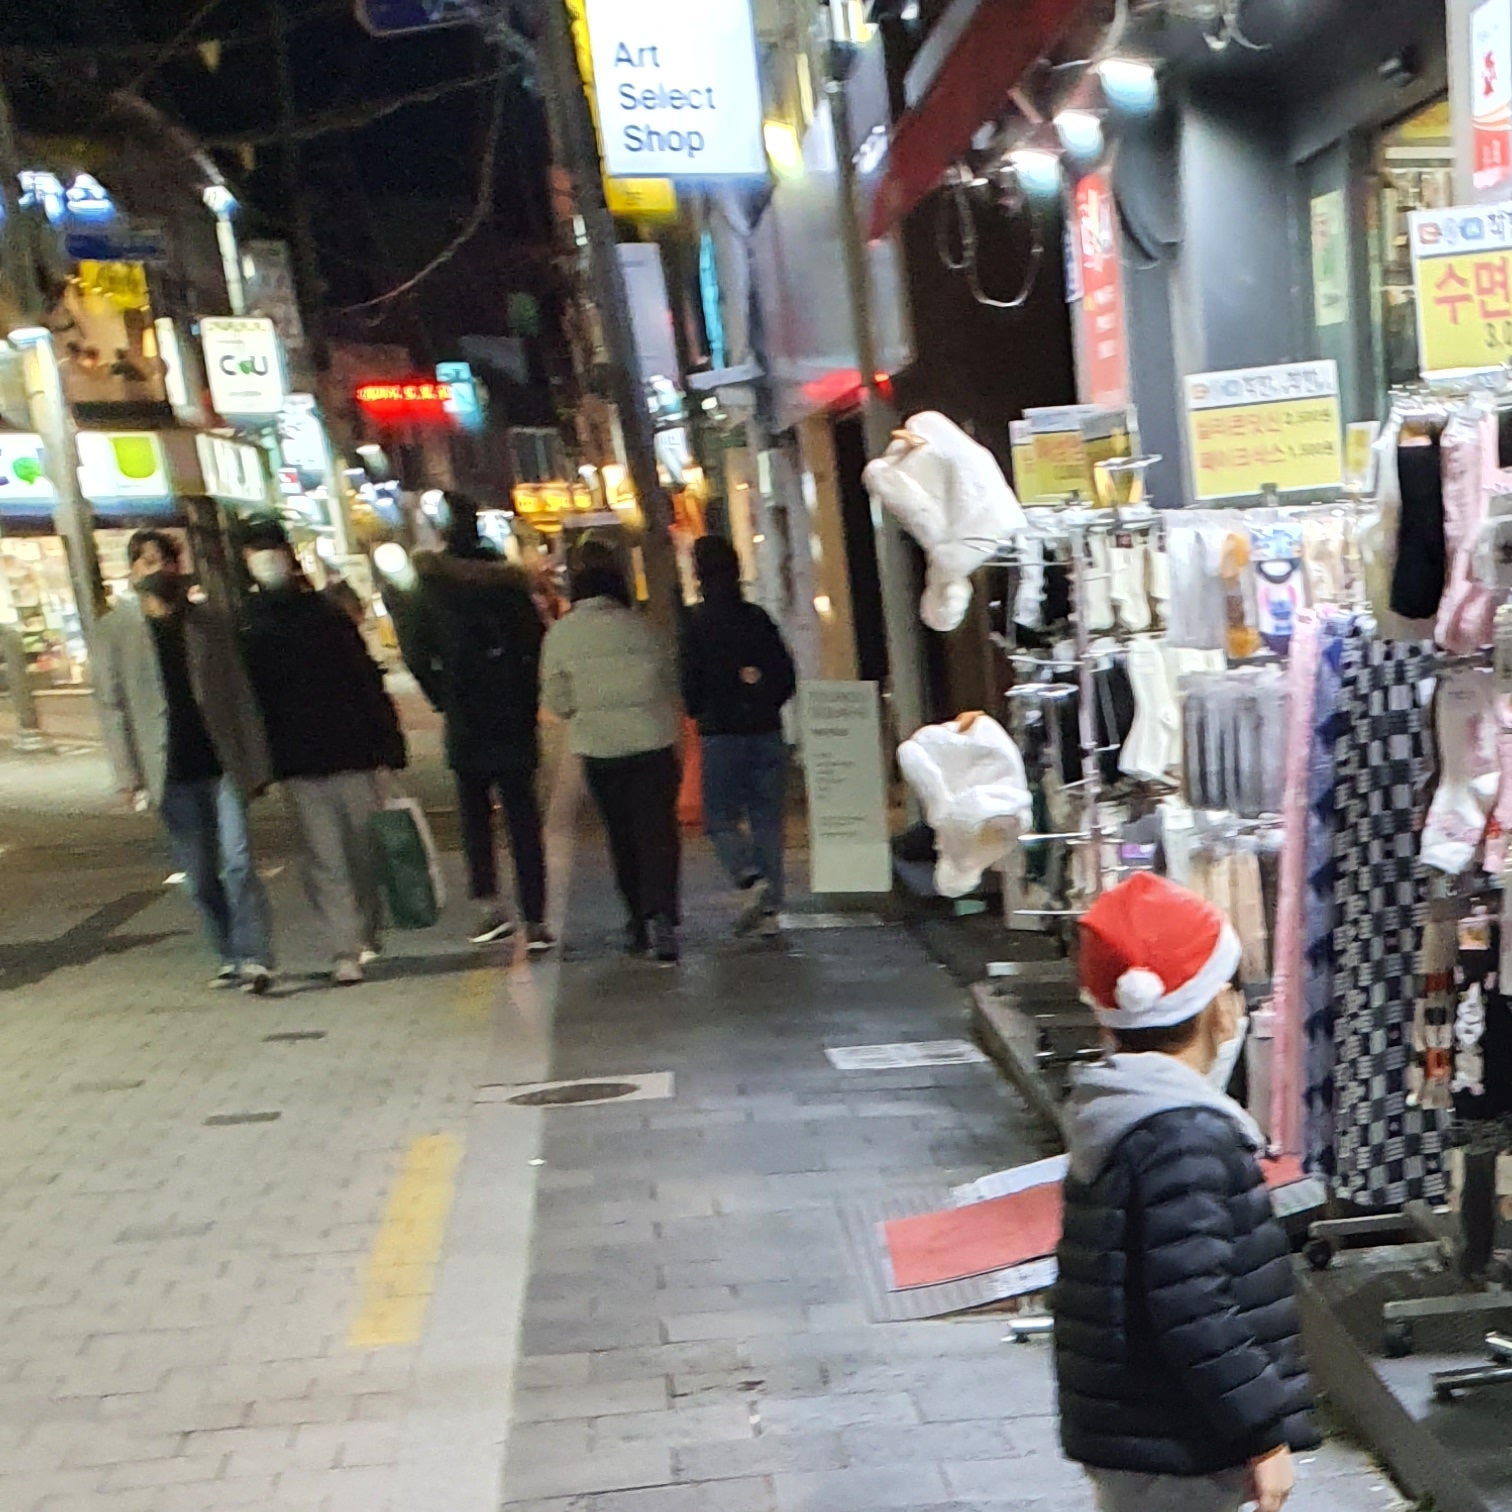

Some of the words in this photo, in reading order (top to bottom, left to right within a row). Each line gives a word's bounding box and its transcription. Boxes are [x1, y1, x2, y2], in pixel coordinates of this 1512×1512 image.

[614, 41, 660, 68] Art
[618, 83, 716, 110] Select
[624, 124, 705, 158] Shop
